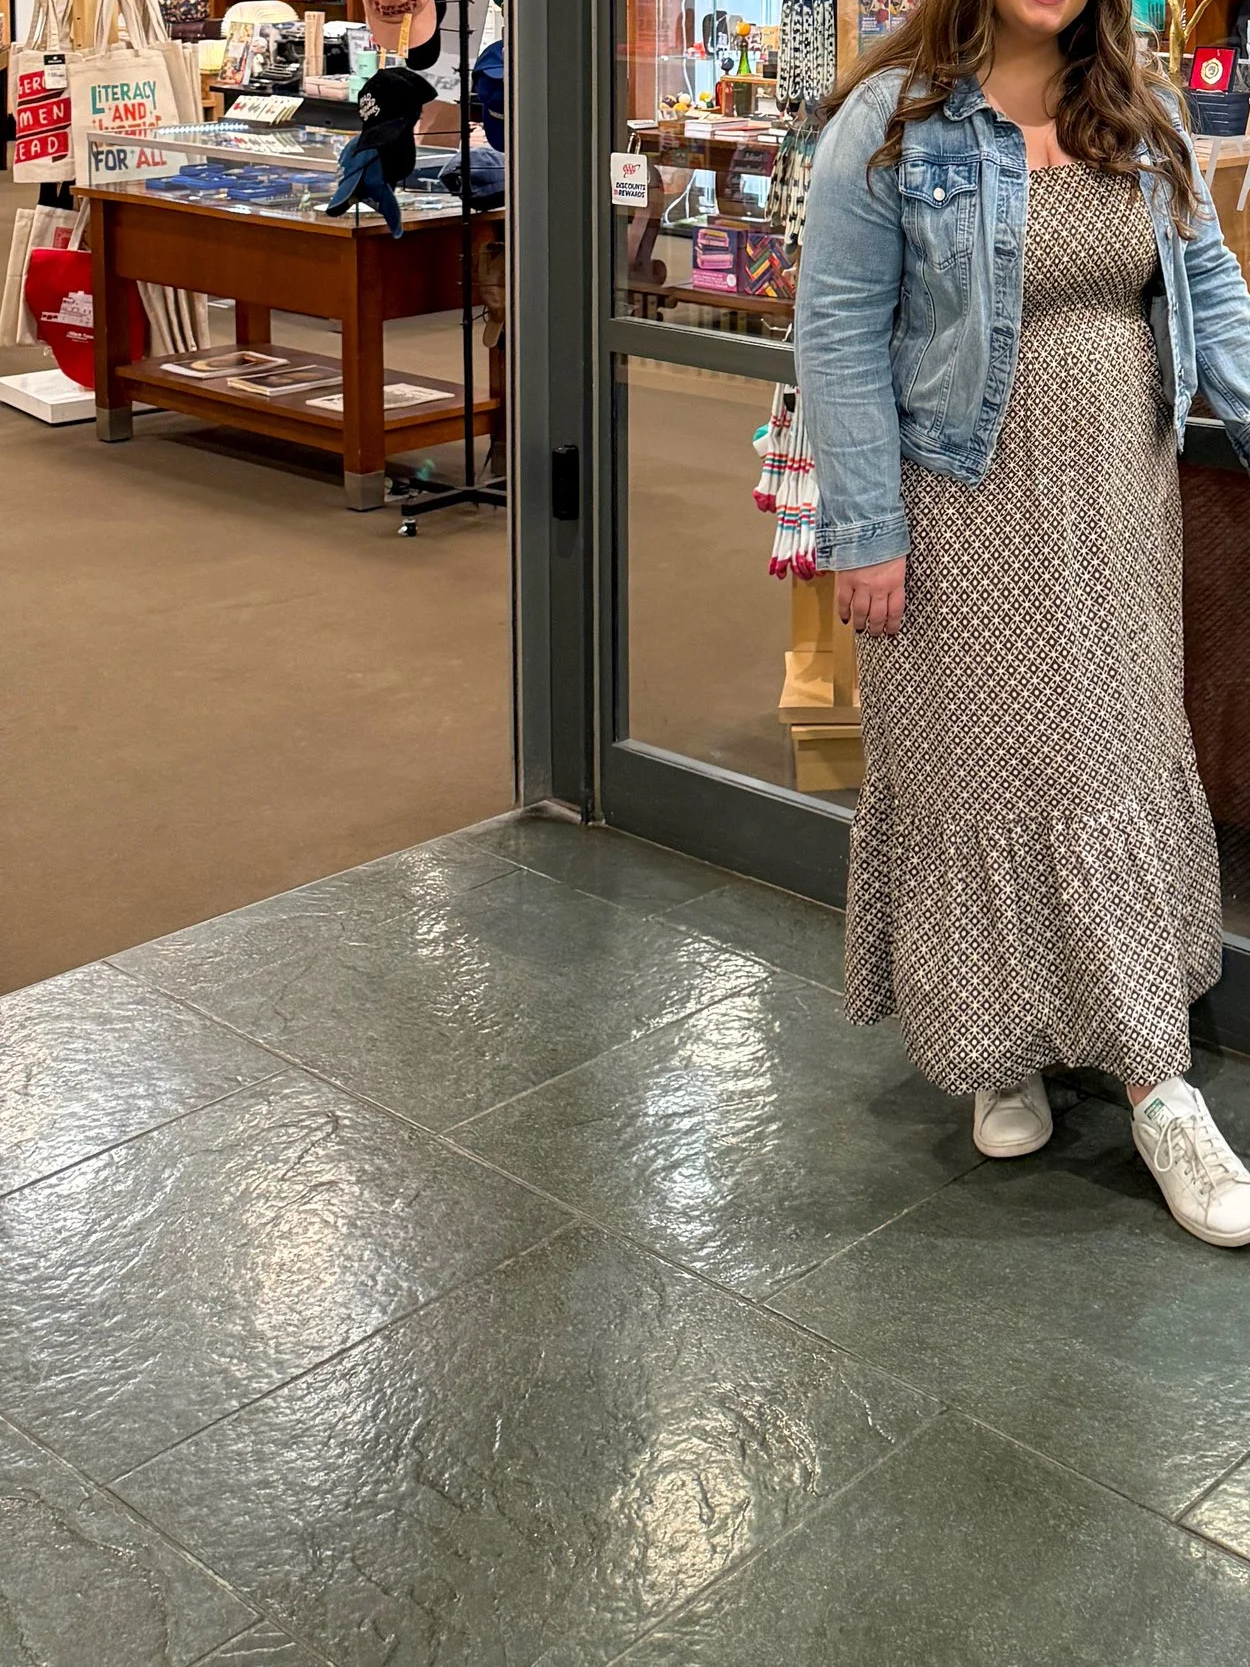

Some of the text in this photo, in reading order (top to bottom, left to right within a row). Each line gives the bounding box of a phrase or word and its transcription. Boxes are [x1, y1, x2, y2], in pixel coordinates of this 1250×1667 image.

[111, 102, 147, 123] AND
[93, 148, 168, 172] FOR ALL
[615, 181, 647, 191] DISCOUNTS
